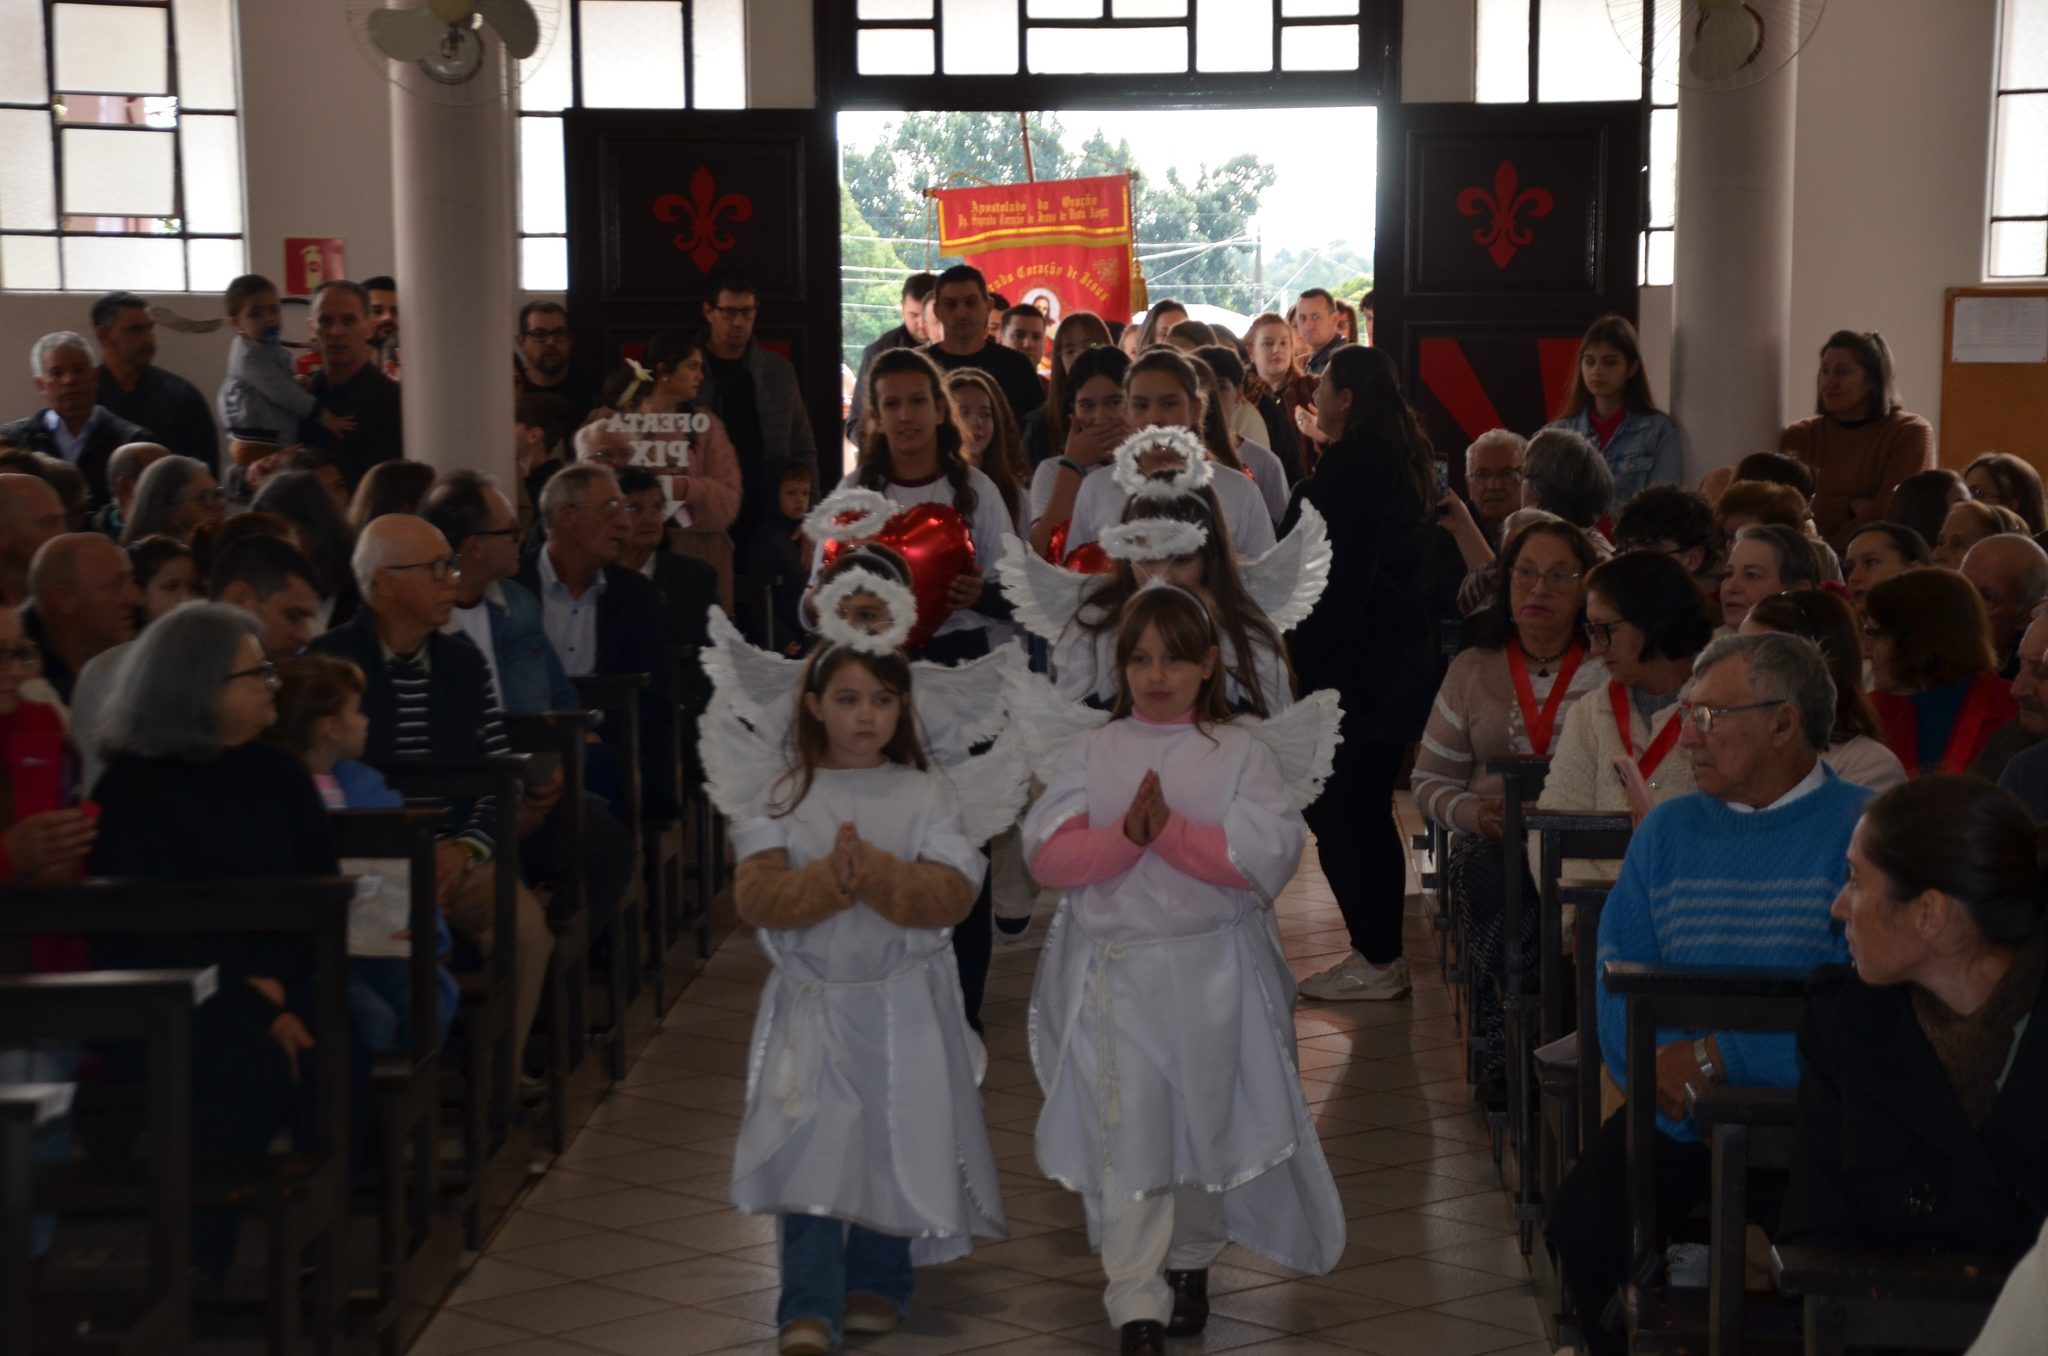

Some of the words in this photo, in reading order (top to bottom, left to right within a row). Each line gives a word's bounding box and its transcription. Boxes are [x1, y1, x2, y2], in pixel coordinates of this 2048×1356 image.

[971, 201, 1026, 215] Apostolado
[1038, 199, 1049, 210] da
[1062, 195, 1098, 209] Oração
[1017, 261, 1062, 279] Coração
[1067, 265, 1077, 279] de
[1080, 271, 1109, 301] Jesus
